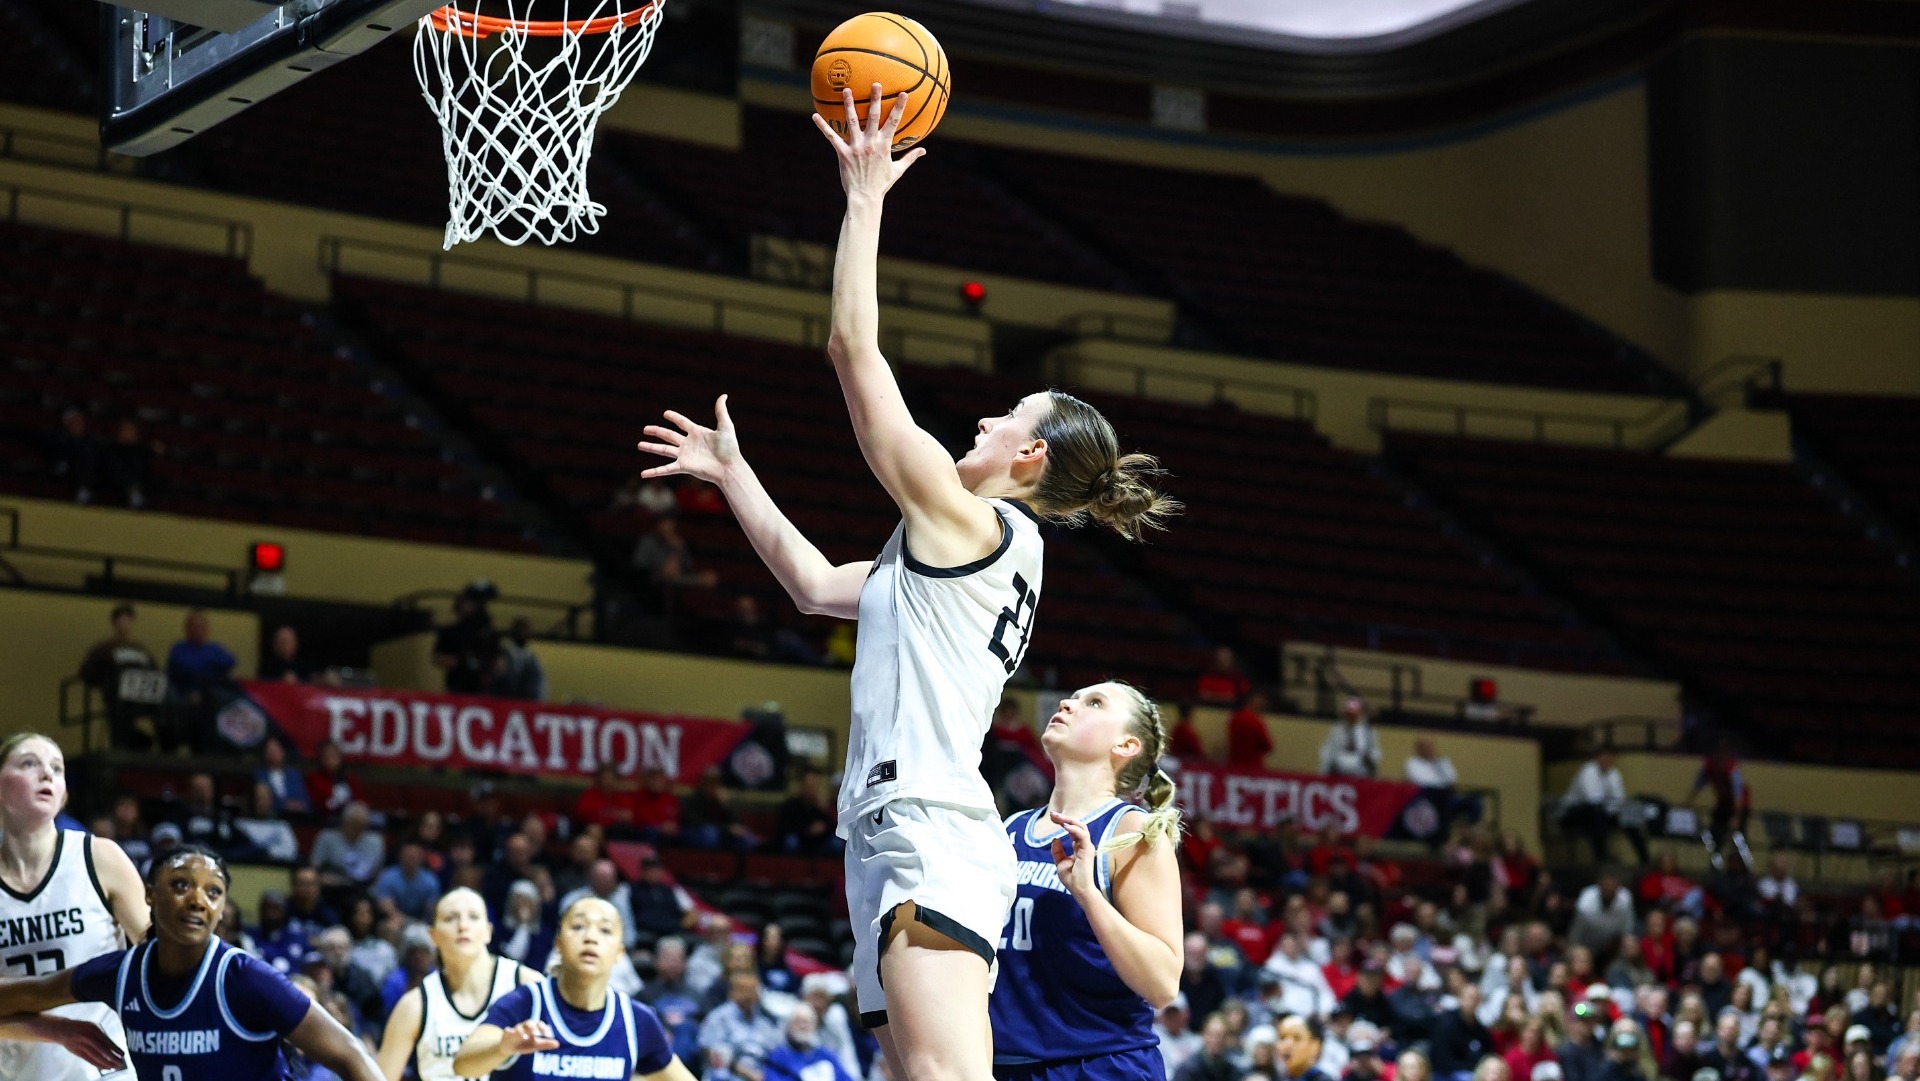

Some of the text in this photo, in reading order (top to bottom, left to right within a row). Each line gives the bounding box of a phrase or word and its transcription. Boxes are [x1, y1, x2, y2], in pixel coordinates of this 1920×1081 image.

[325, 698, 682, 779] EDUCATION
[127, 1028, 219, 1054] WASHBURN
[533, 1053, 625, 1079] WASHBURN
